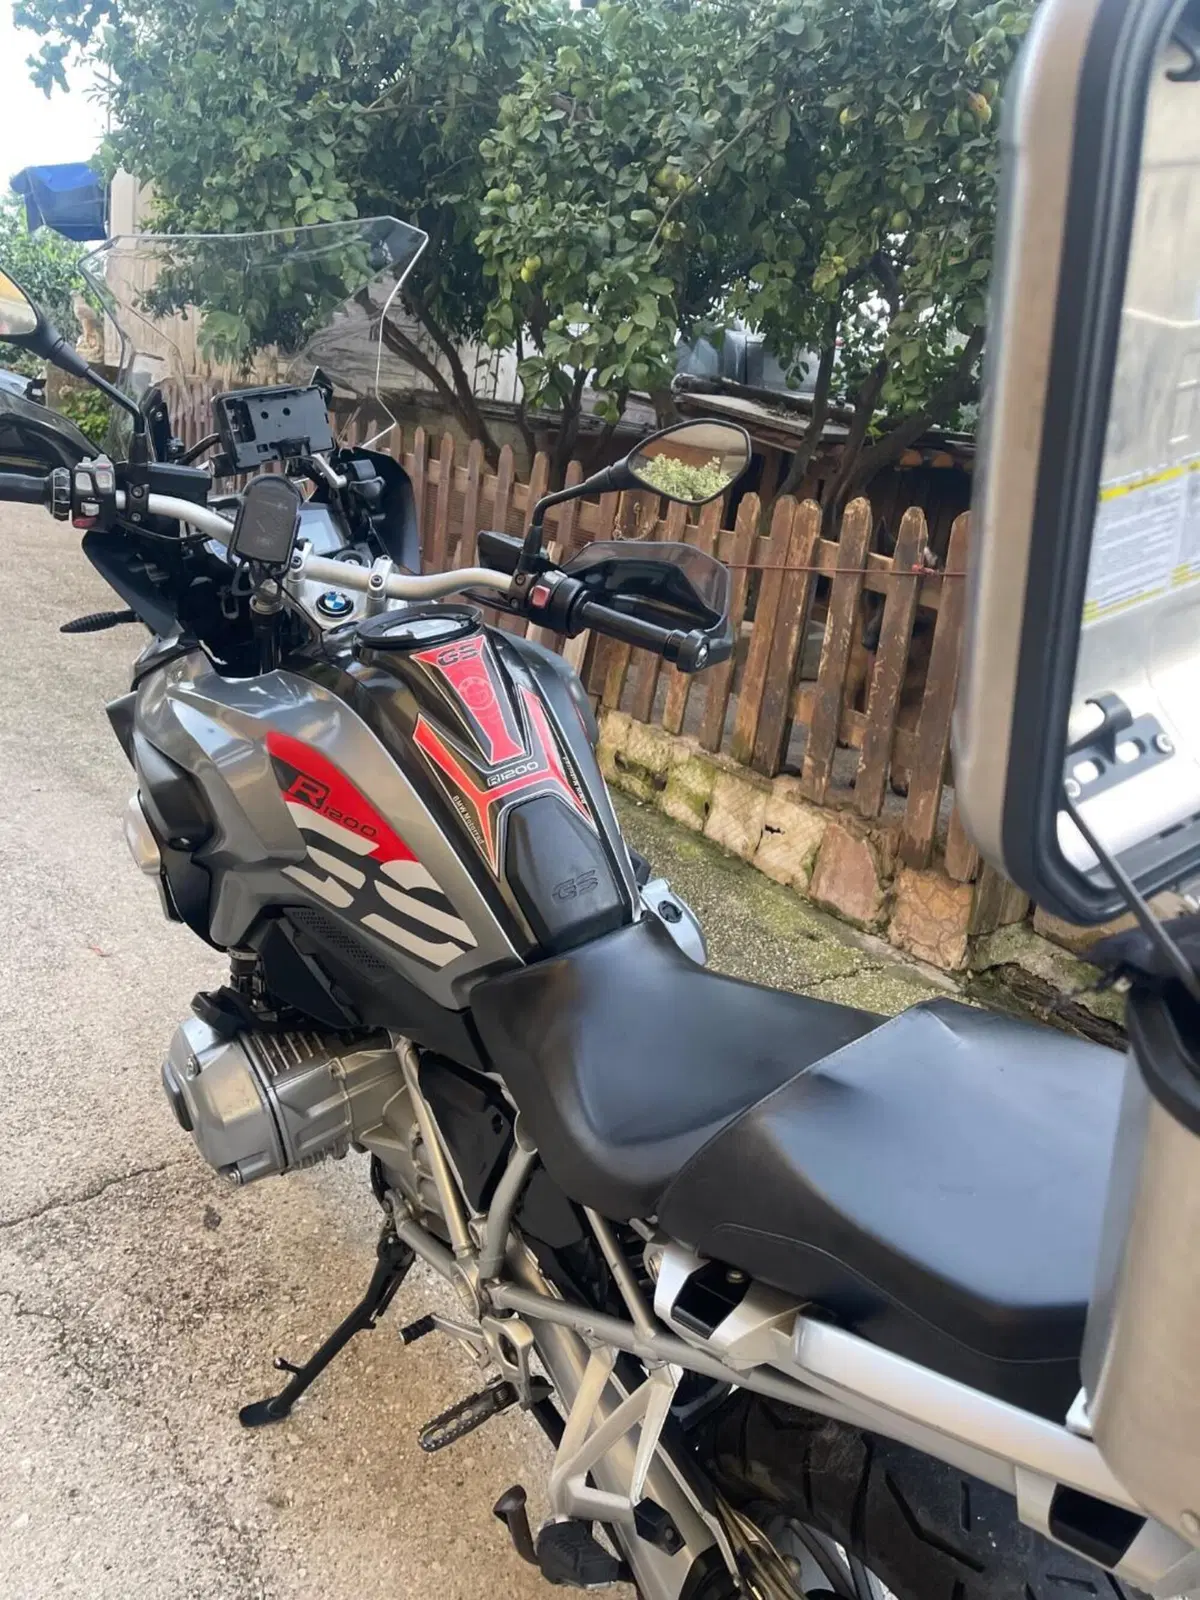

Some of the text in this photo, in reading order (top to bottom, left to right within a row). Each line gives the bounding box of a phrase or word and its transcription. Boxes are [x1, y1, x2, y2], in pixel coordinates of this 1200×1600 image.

[437, 642, 479, 667] GS
[487, 761, 539, 787] R1200
[452, 795, 485, 845] BMW Motorrad
[551, 869, 599, 901] GS
